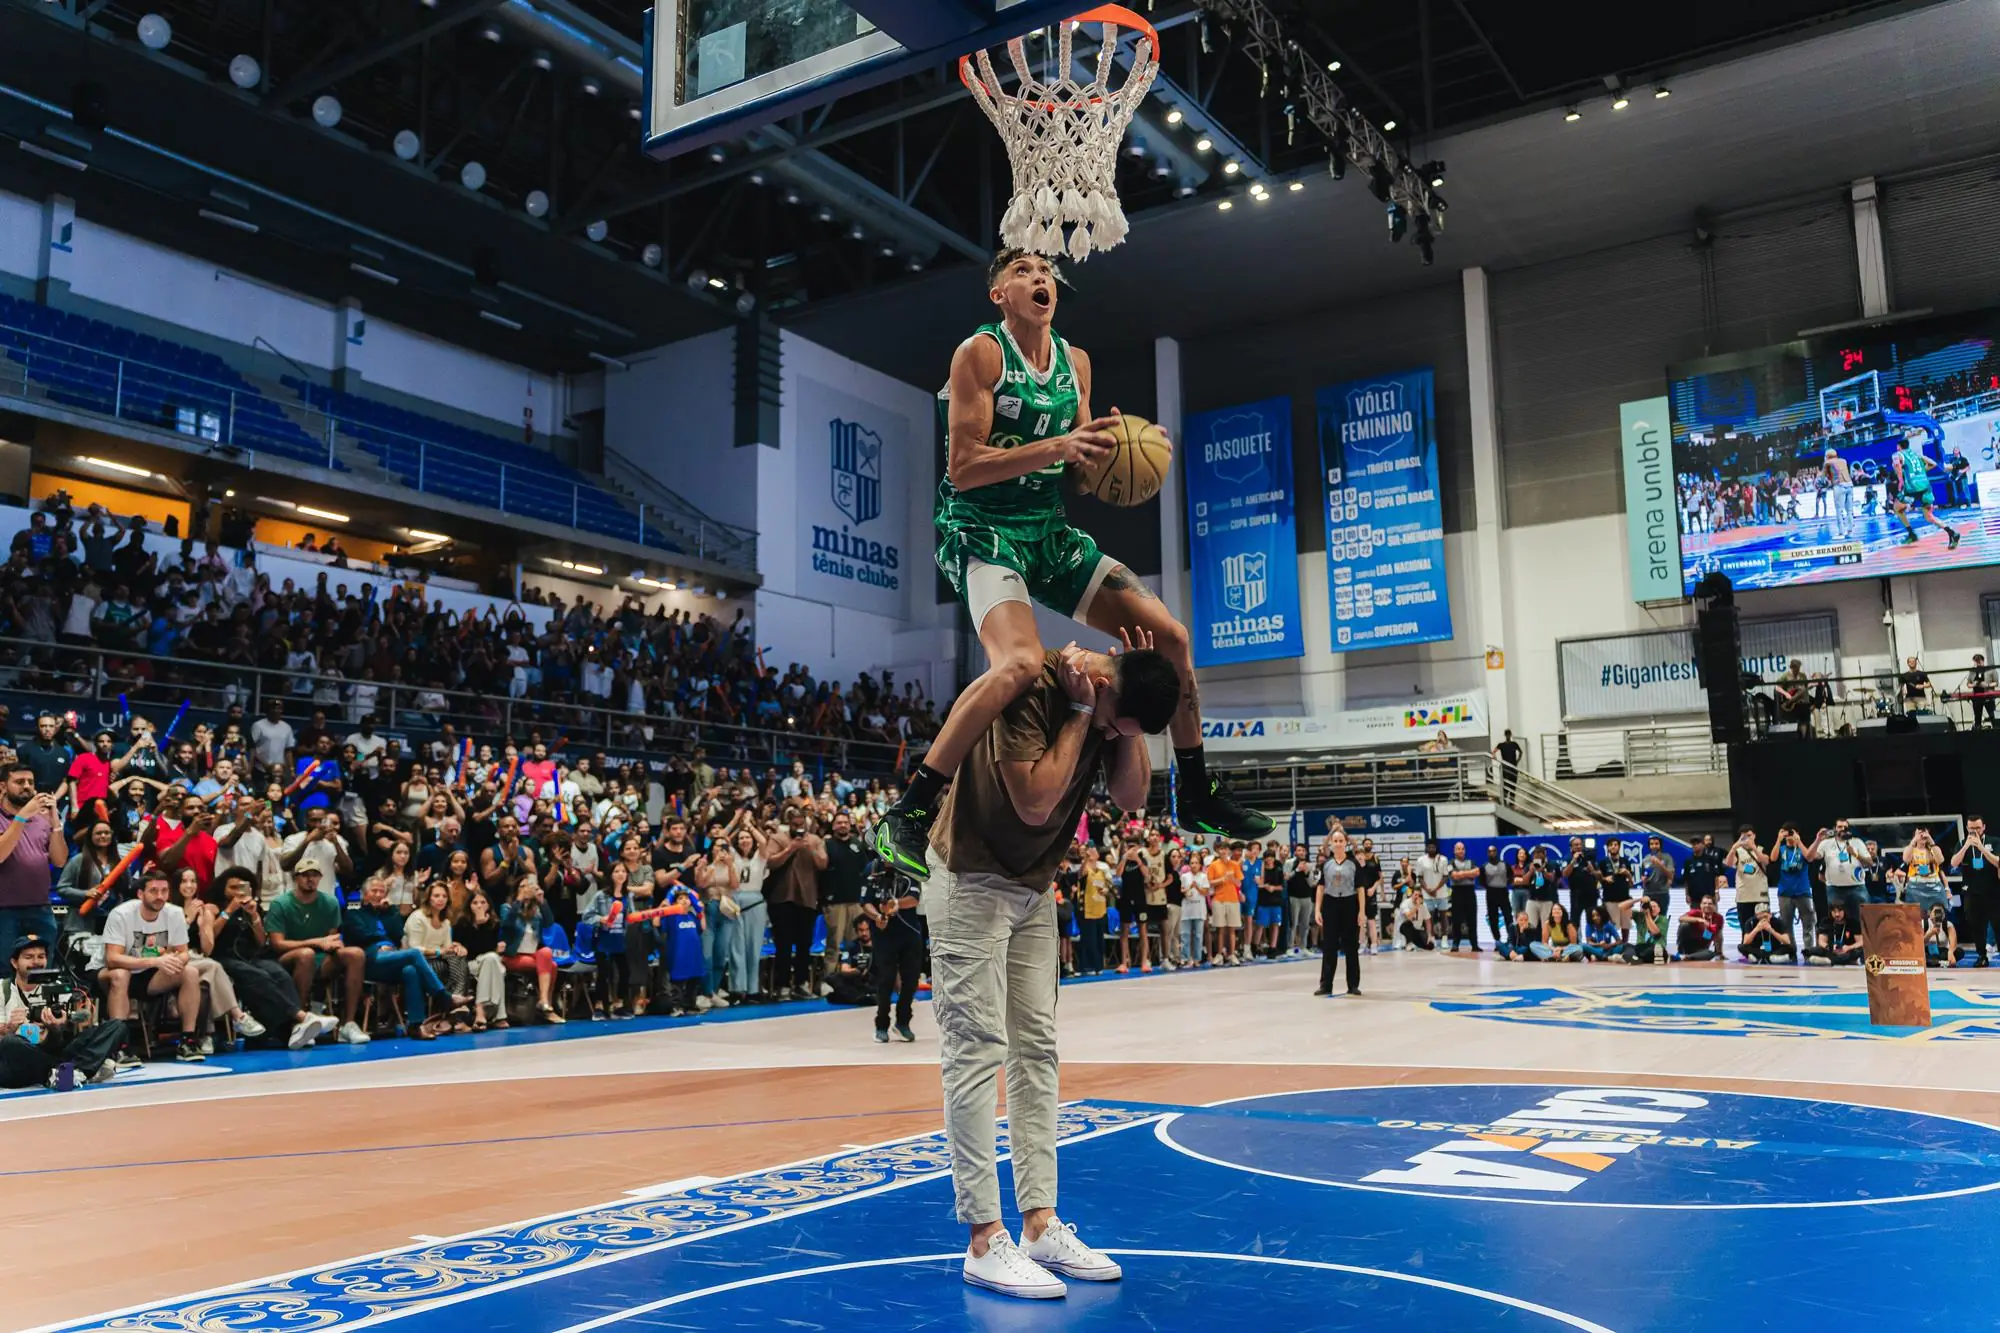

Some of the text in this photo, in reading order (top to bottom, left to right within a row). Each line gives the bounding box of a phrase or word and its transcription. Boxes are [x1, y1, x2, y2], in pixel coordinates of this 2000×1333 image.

[1355, 390, 1395, 417] VÔLEI
[1341, 411, 1412, 444] FEMININO
[1205, 432, 1272, 464] BASQUETE
[1395, 456, 1421, 471] BRASIL
[1407, 489, 1434, 504] BRASIL
[1635, 429, 1668, 580] arena unibh
[1230, 518, 1247, 530] COPA
[1248, 514, 1271, 527] SUPER
[812, 524, 899, 570] minas
[1791, 545, 1853, 558] LUCAS BRANDÃO
[812, 550, 899, 590] tênis clube
[1376, 564, 1393, 577] LIGA
[1394, 558, 1432, 574] NACIONAL
[1211, 614, 1285, 638] minas
[1374, 621, 1419, 638] SUPERCOPA
[1212, 631, 1285, 649] tênis clube
[1403, 704, 1473, 728] BRASIL
[1201, 721, 1265, 738] CAIXA
[1357, 1089, 1710, 1192] CAIXA
[1376, 1119, 1761, 1150] ARREMESSO
